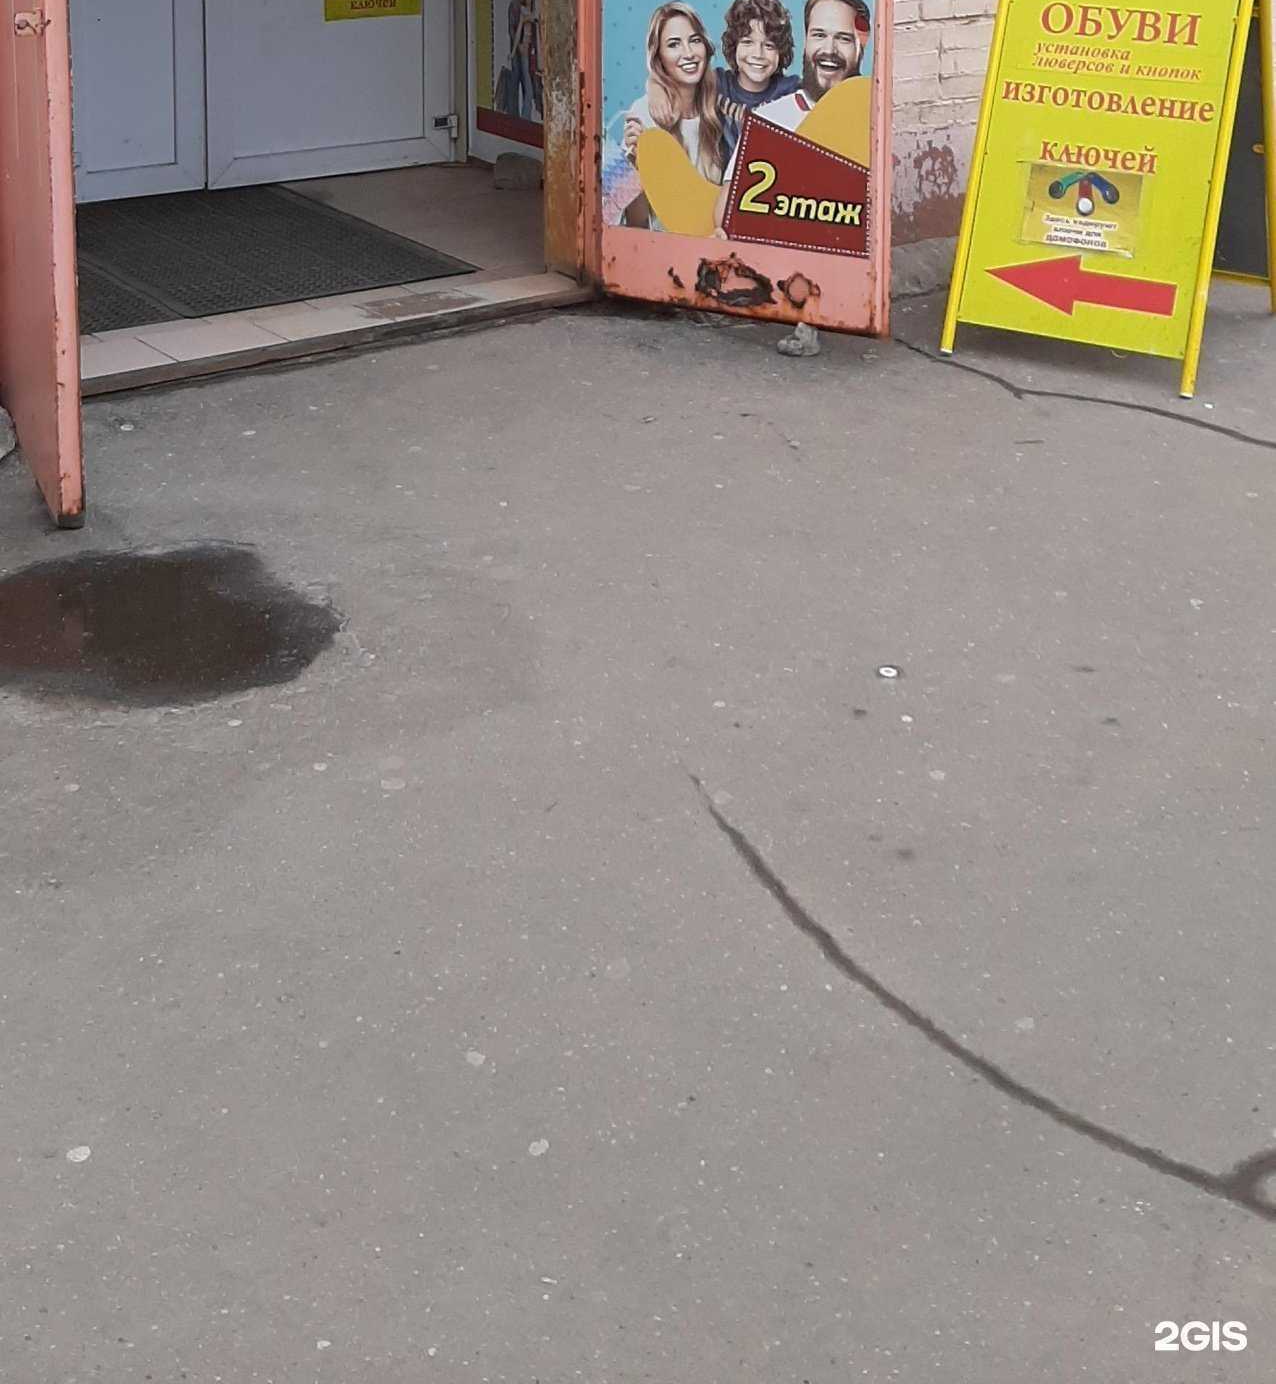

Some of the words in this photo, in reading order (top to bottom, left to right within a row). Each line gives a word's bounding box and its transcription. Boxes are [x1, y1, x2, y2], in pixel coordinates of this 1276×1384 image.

[1040, 1, 1202, 47] ОБУВИ
[1034, 41, 1131, 62] установка
[1118, 63, 1130, 74] и
[1135, 64, 1202, 81] кнопок
[1001, 79, 1215, 123] изготовление
[1039, 139, 1158, 175] ключей
[738, 160, 776, 214] 2
[773, 194, 863, 226] этаж
